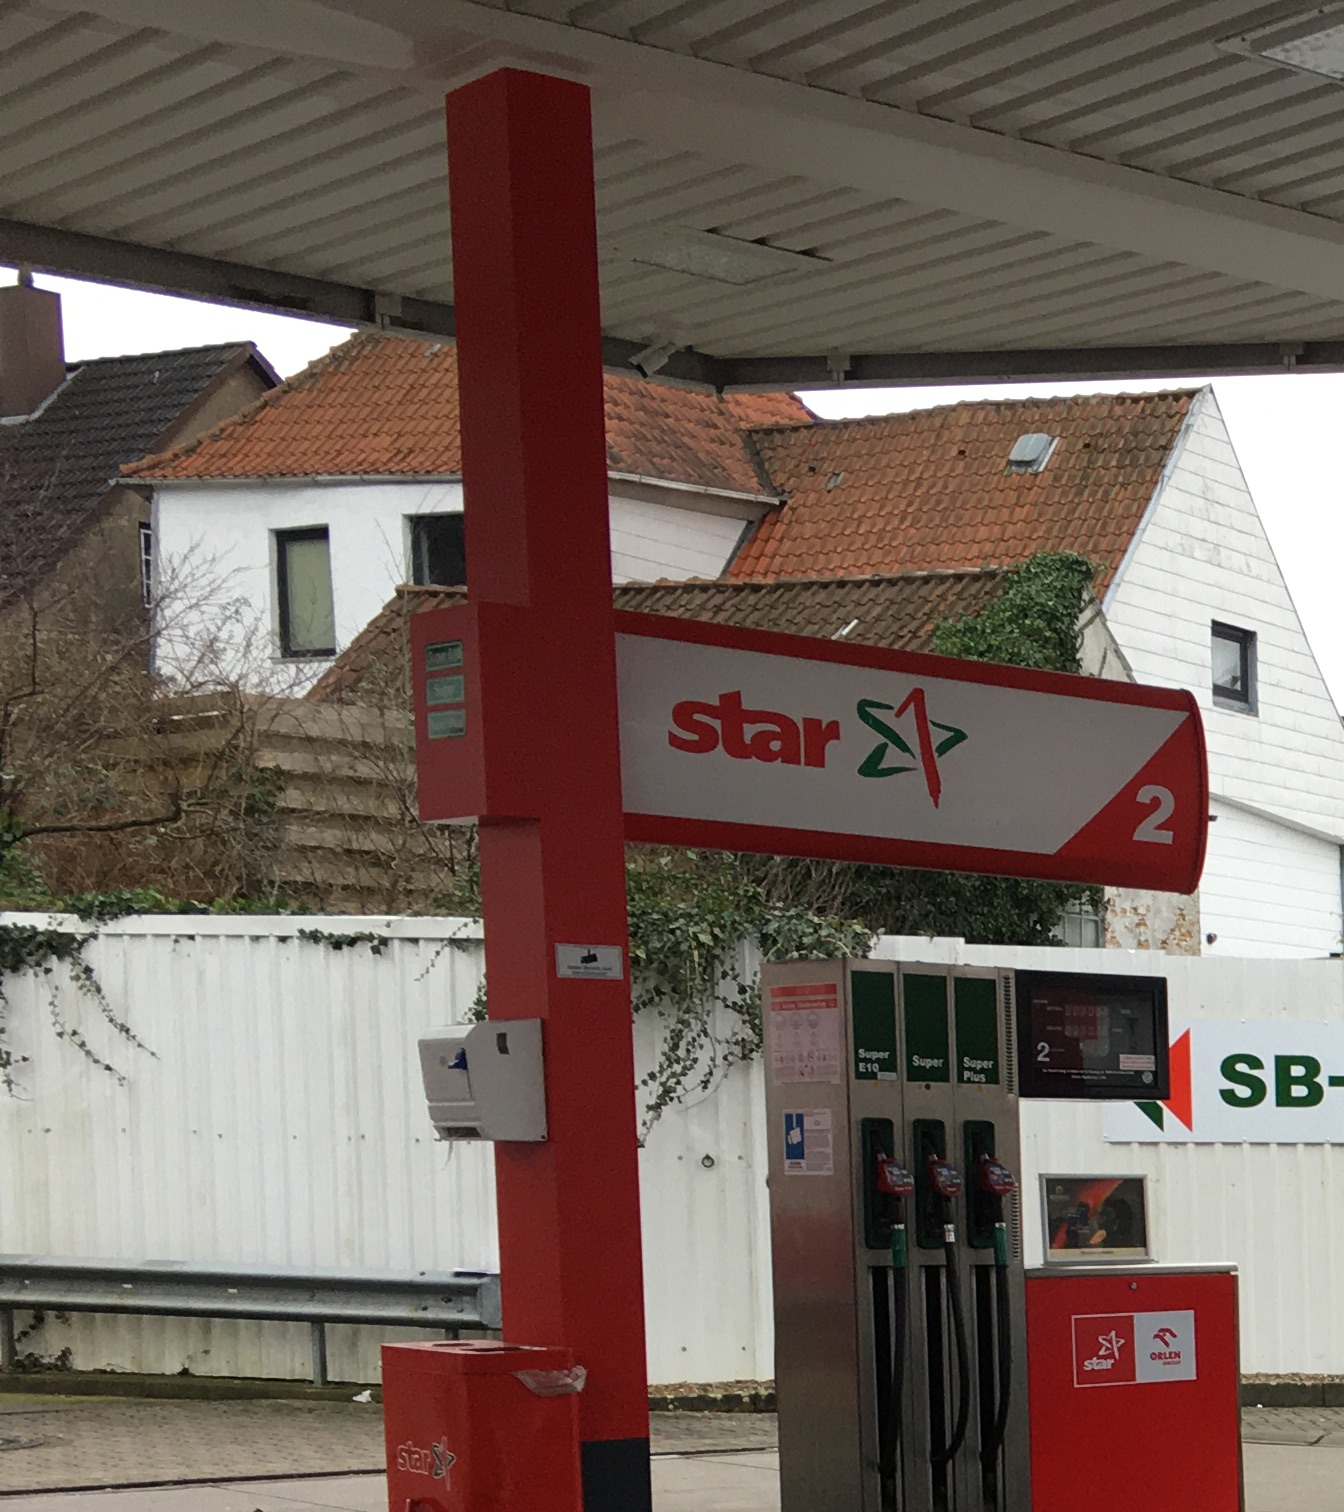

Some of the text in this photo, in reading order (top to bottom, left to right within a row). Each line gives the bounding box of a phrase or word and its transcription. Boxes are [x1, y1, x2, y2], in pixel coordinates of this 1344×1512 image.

[668, 690, 841, 769] star
[1132, 784, 1175, 845] 2
[858, 1048, 890, 1060] Super
[1036, 1041, 1050, 1062] 2
[859, 1062, 880, 1073] E10
[912, 1055, 944, 1068] Super
[963, 1057, 994, 1070] Super
[963, 1071, 986, 1083] Plus
[1150, 1350, 1182, 1362] ORLEN
[1083, 1357, 1115, 1372] star
[397, 1441, 432, 1475] star
